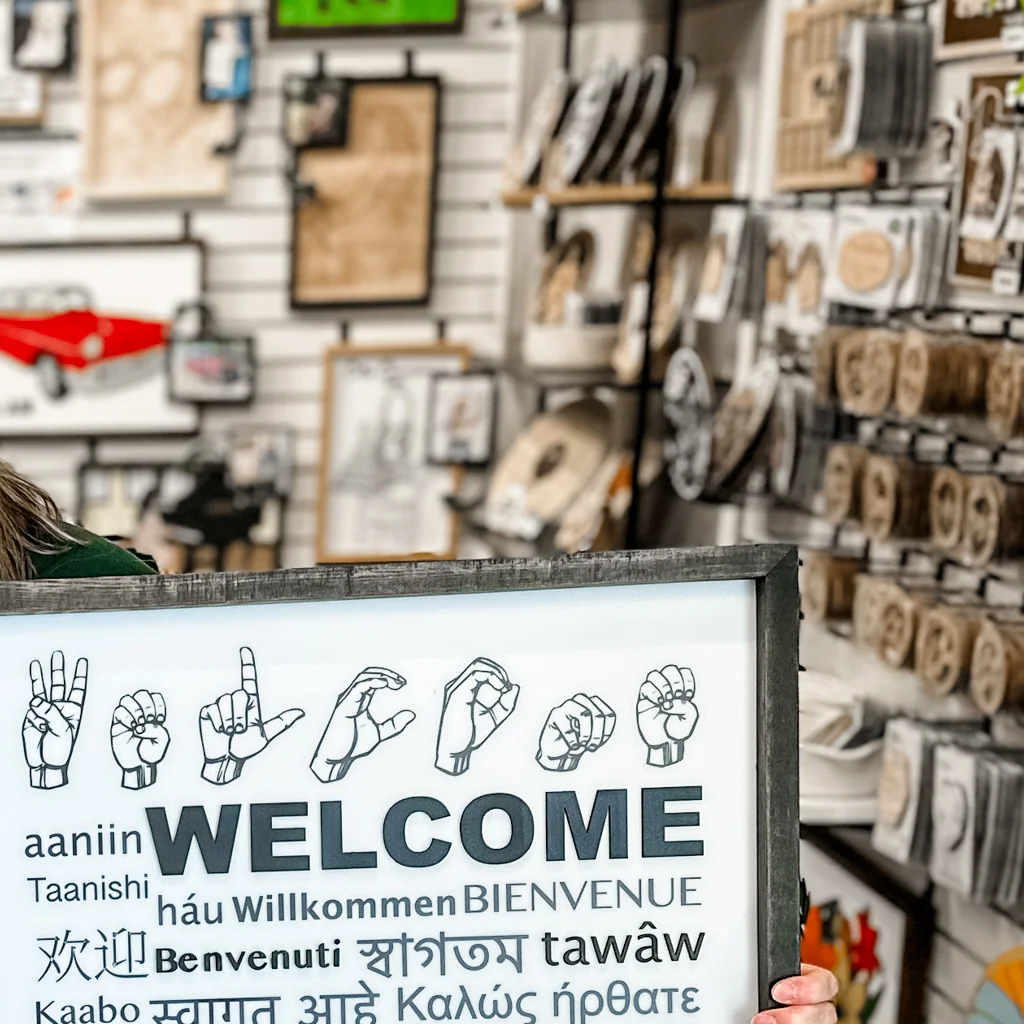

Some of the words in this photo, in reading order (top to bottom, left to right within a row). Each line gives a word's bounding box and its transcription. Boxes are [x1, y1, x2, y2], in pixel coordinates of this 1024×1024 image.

[25, 823, 141, 858] aaniin
[145, 785, 704, 876] WELCOME
[27, 873, 148, 902] Taanishi
[464, 877, 702, 913] BIENVENUE
[158, 893, 222, 926] háu
[232, 892, 456, 922] Willkommen
[37, 928, 149, 983] 欢迎
[155, 939, 340, 973] Benvenuti
[357, 931, 529, 978] স্বাগতম
[541, 921, 705, 966] tawâw
[36, 995, 140, 1024] Kaabo
[553, 980, 700, 1024] ήρθατε
